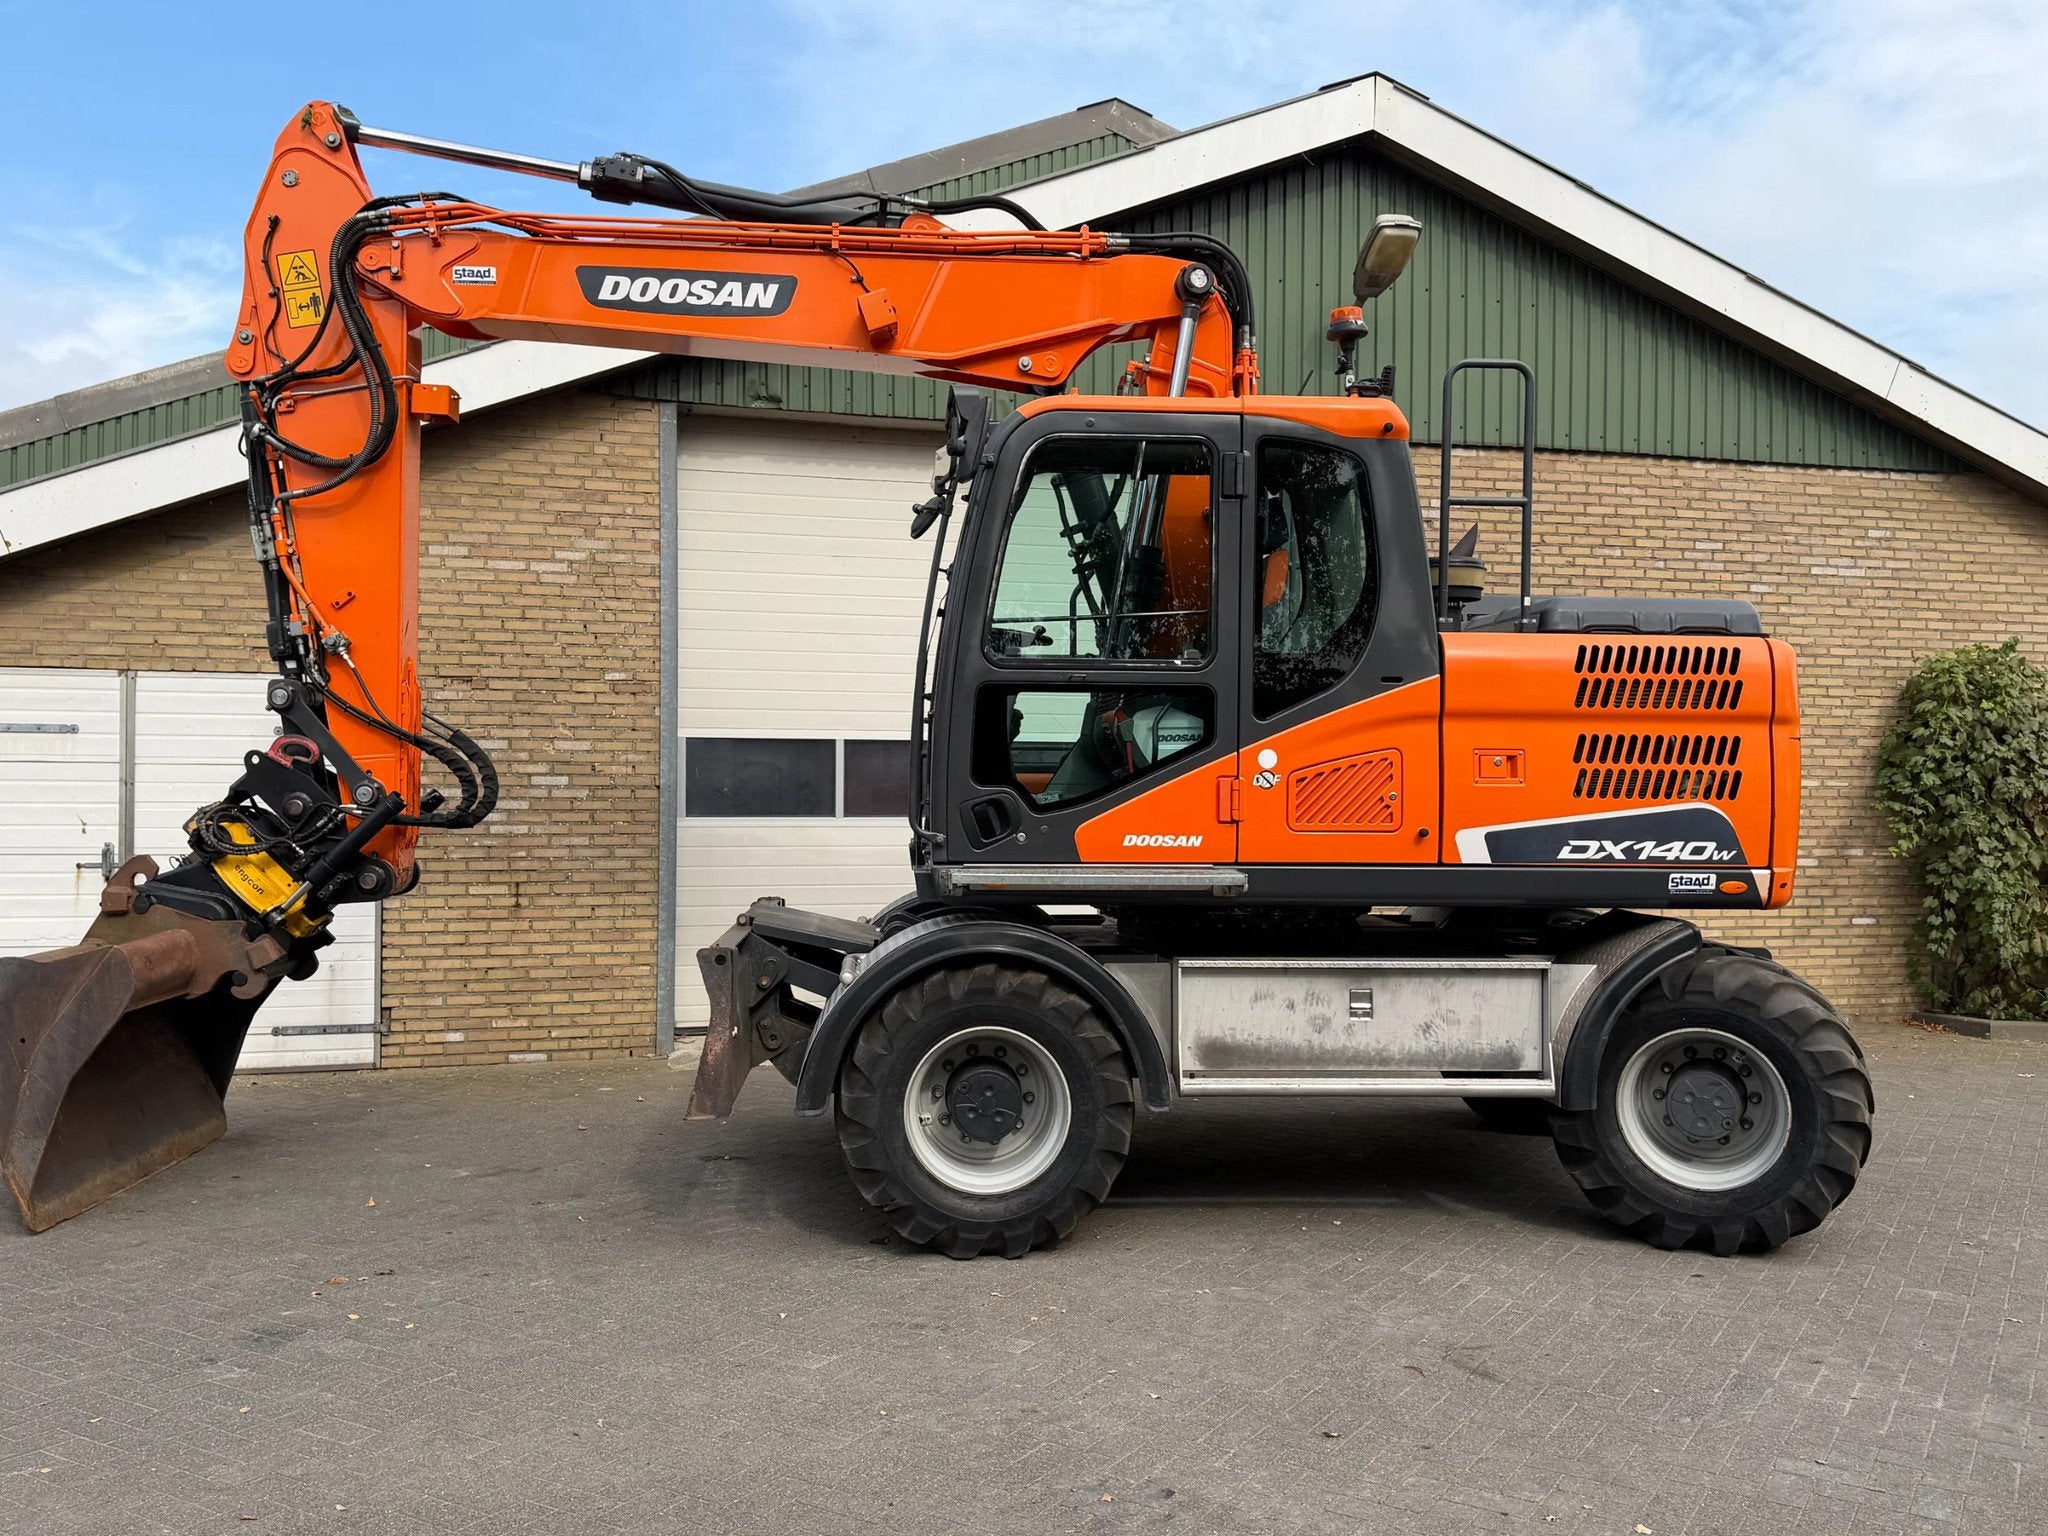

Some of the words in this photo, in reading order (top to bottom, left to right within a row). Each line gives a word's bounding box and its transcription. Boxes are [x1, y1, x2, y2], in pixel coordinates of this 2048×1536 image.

[597, 275, 780, 309] DOOSAN
[1122, 834, 1204, 847] DOOSAN
[234, 864, 265, 895] engcon
